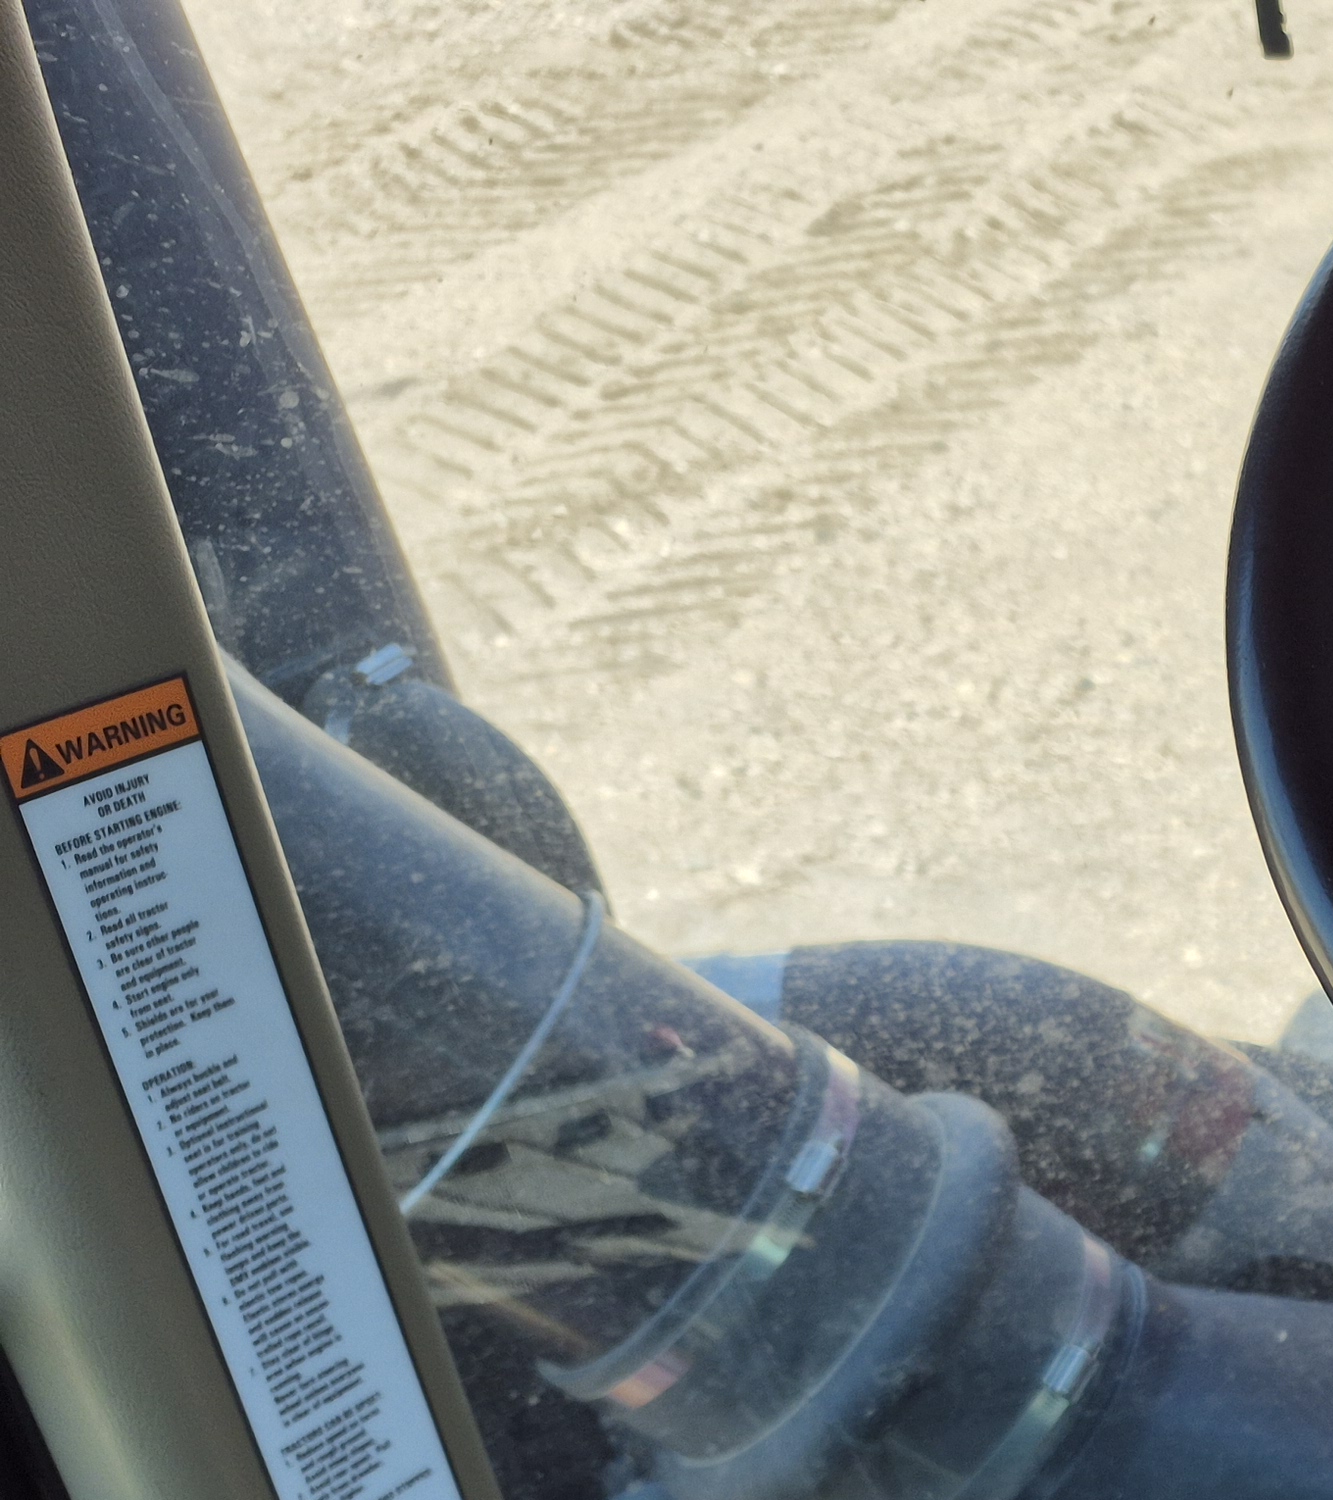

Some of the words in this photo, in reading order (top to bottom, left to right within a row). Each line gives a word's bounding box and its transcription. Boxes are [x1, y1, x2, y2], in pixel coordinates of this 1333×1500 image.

[54, 703, 187, 766] WARNING
[83, 787, 114, 808] AVOID
[114, 773, 150, 796] INJURY
[97, 803, 113, 818] OR
[112, 790, 146, 812] DEATH
[54, 832, 93, 856] BEFORE
[93, 813, 143, 841] STARTING
[73, 846, 98, 866] Read
[98, 843, 115, 856] the
[116, 823, 163, 849] operator's
[79, 857, 114, 880] manual
[114, 853, 128, 866] for
[130, 842, 159, 860] safety
[84, 866, 138, 895] information
[139, 856, 156, 873] and
[90, 884, 134, 910] operating
[99, 918, 124, 936] Read
[125, 912, 137, 927] all
[137, 901, 168, 921] tractor
[105, 932, 134, 951] safety
[109, 952, 123, 965] Be
[124, 943, 145, 959] sure
[146, 932, 169, 949] other
[170, 920, 200, 941] people
[115, 965, 131, 979] are
[131, 955, 153, 971] clear
[155, 947, 165, 961] of
[166, 936, 196, 956] tractor
[120, 975, 138, 992] and
